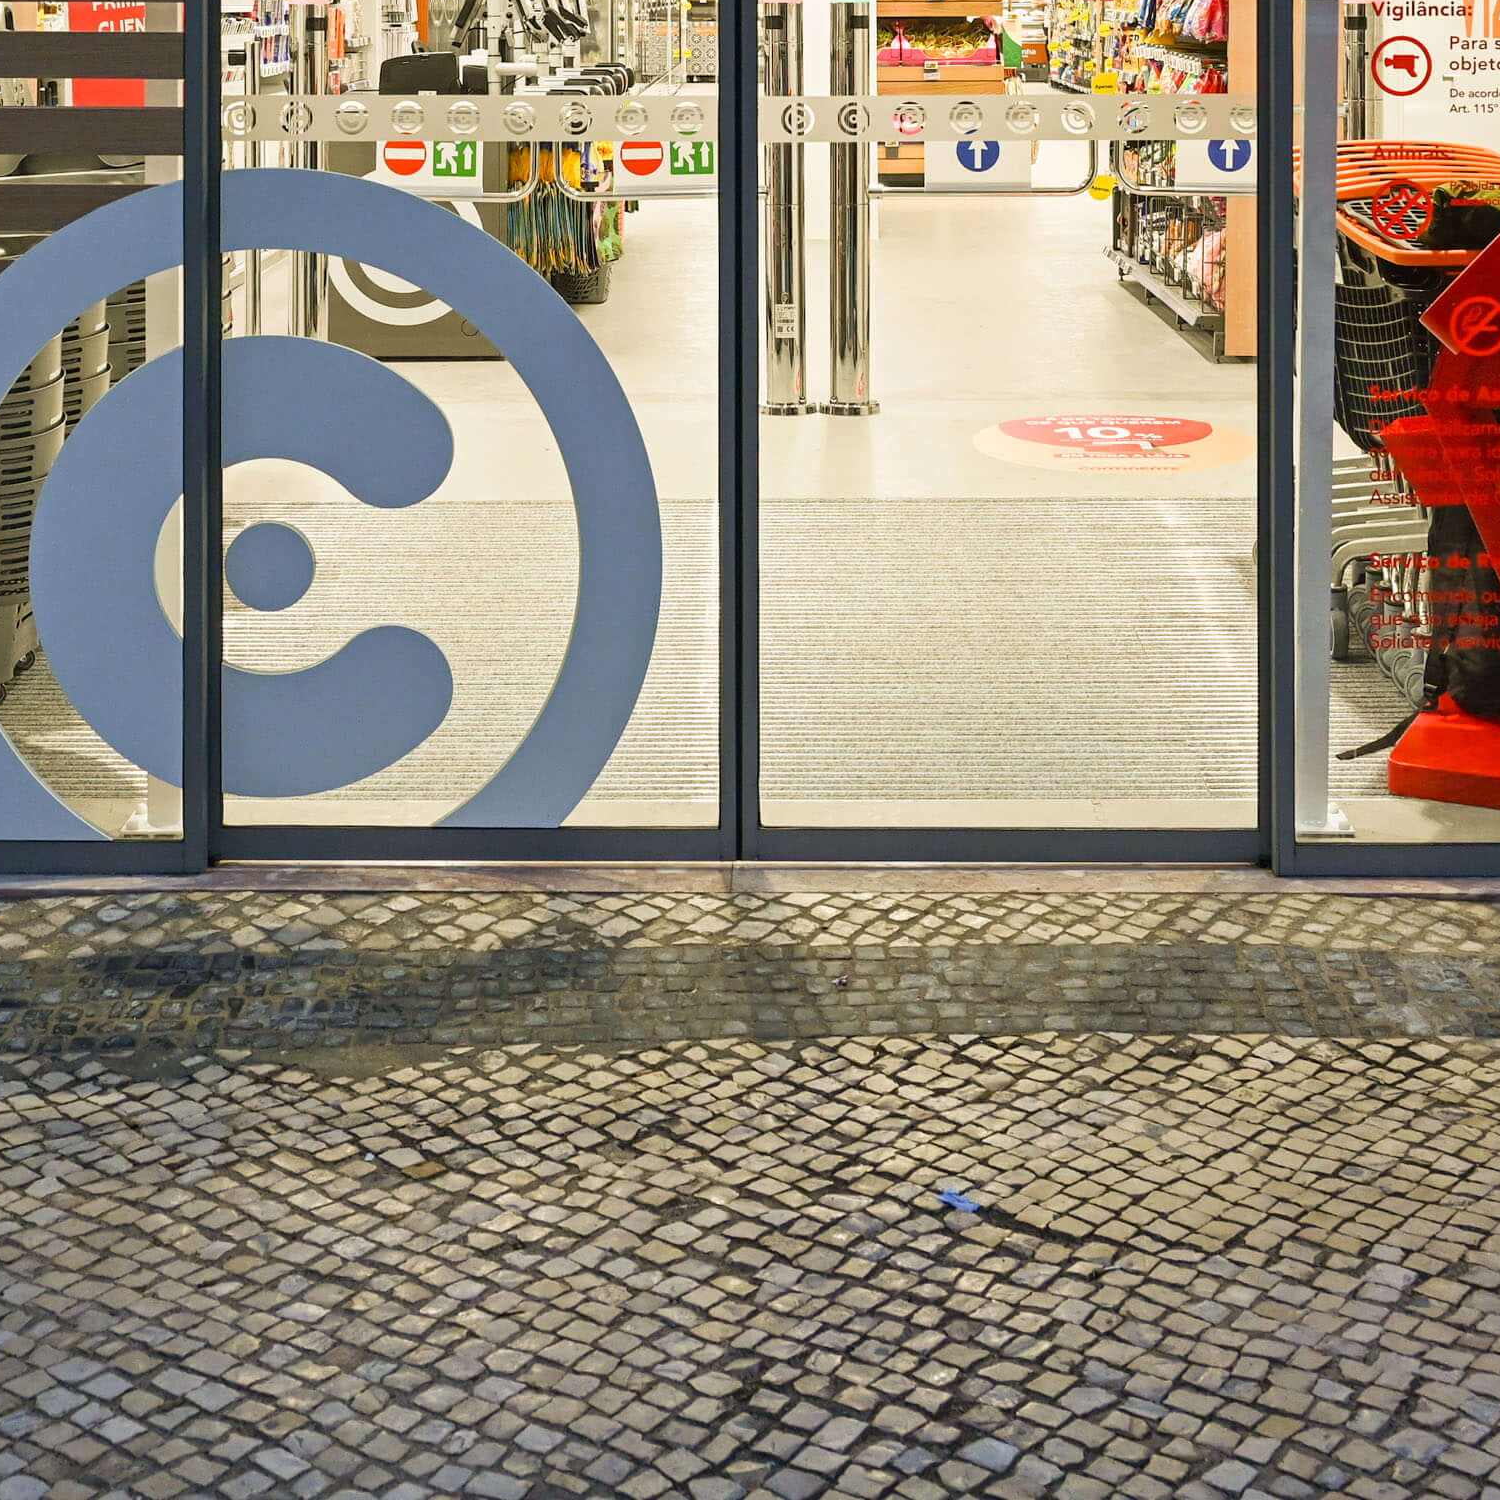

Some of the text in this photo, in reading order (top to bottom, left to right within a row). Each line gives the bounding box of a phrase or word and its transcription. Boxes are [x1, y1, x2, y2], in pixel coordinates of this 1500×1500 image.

[1372, 1, 1473, 21] Vigilância:
[1449, 36, 1487, 51] Para
[1450, 89, 1465, 99] De
[1449, 103, 1471, 114] Art.
[1054, 426, 1164, 440] 10%
[1446, 552, 1471, 569] de
